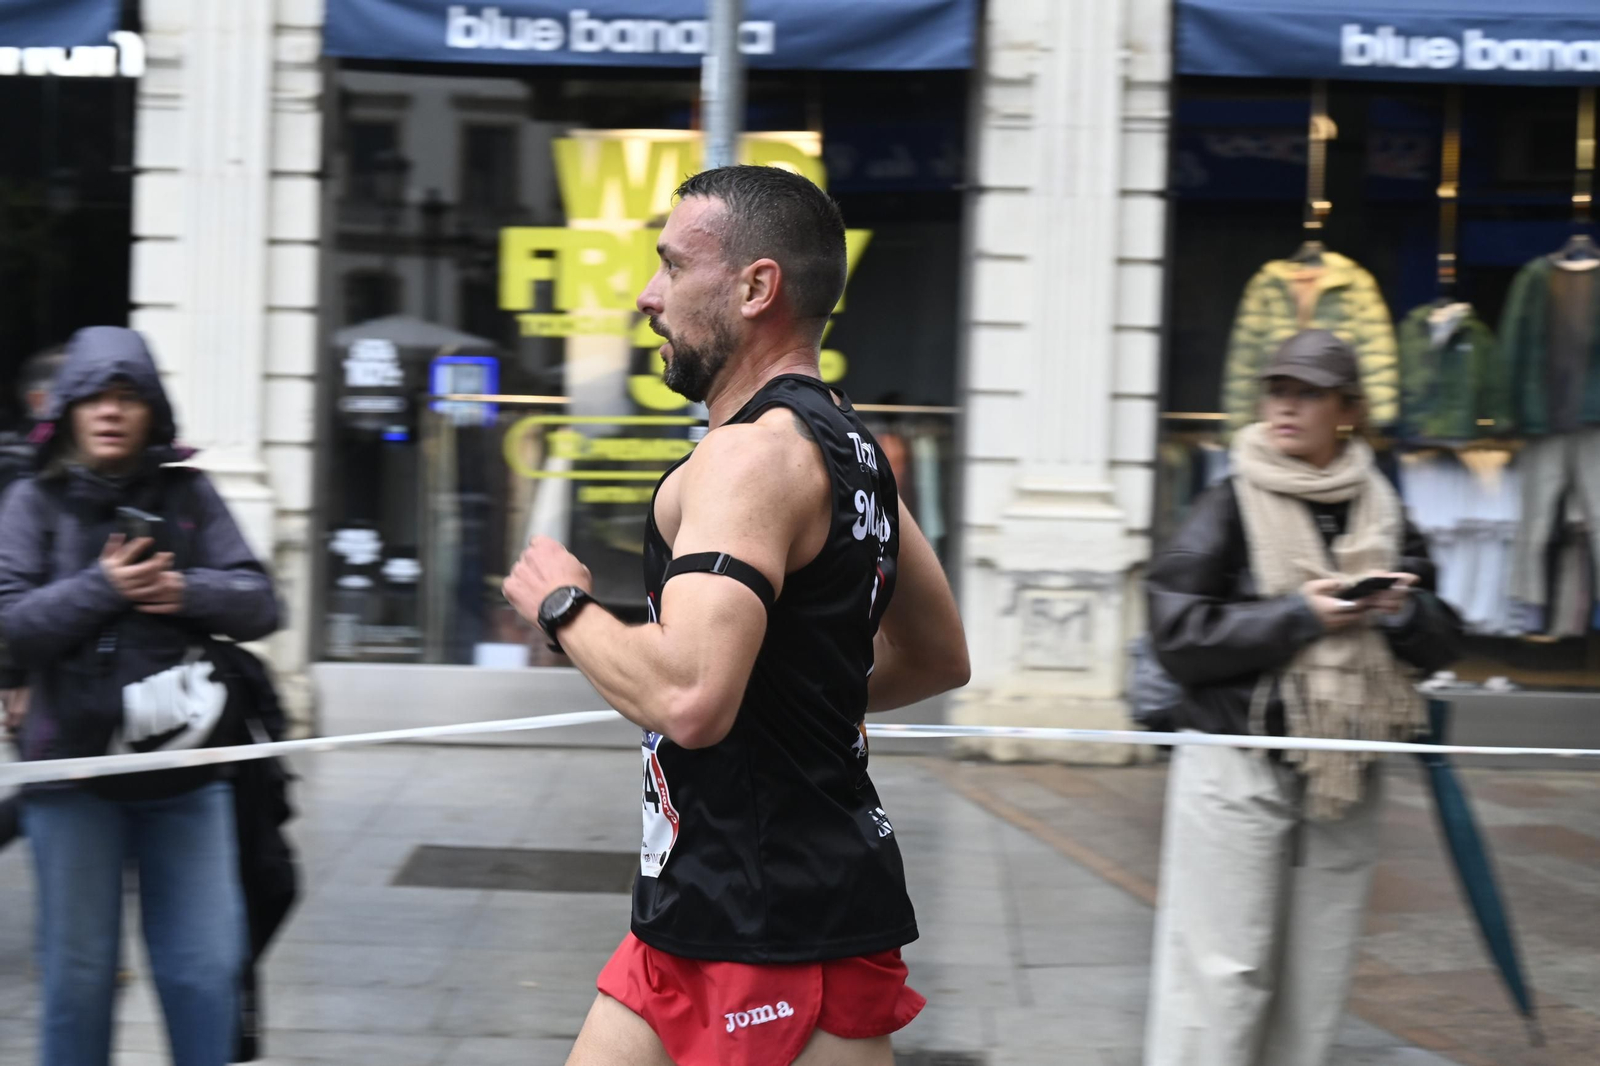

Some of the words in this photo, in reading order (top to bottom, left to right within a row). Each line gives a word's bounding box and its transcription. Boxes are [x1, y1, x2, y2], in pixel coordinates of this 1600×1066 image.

[446, 6, 565, 50] blue
[568, 9, 776, 54] banaa
[1339, 24, 1460, 69] blue
